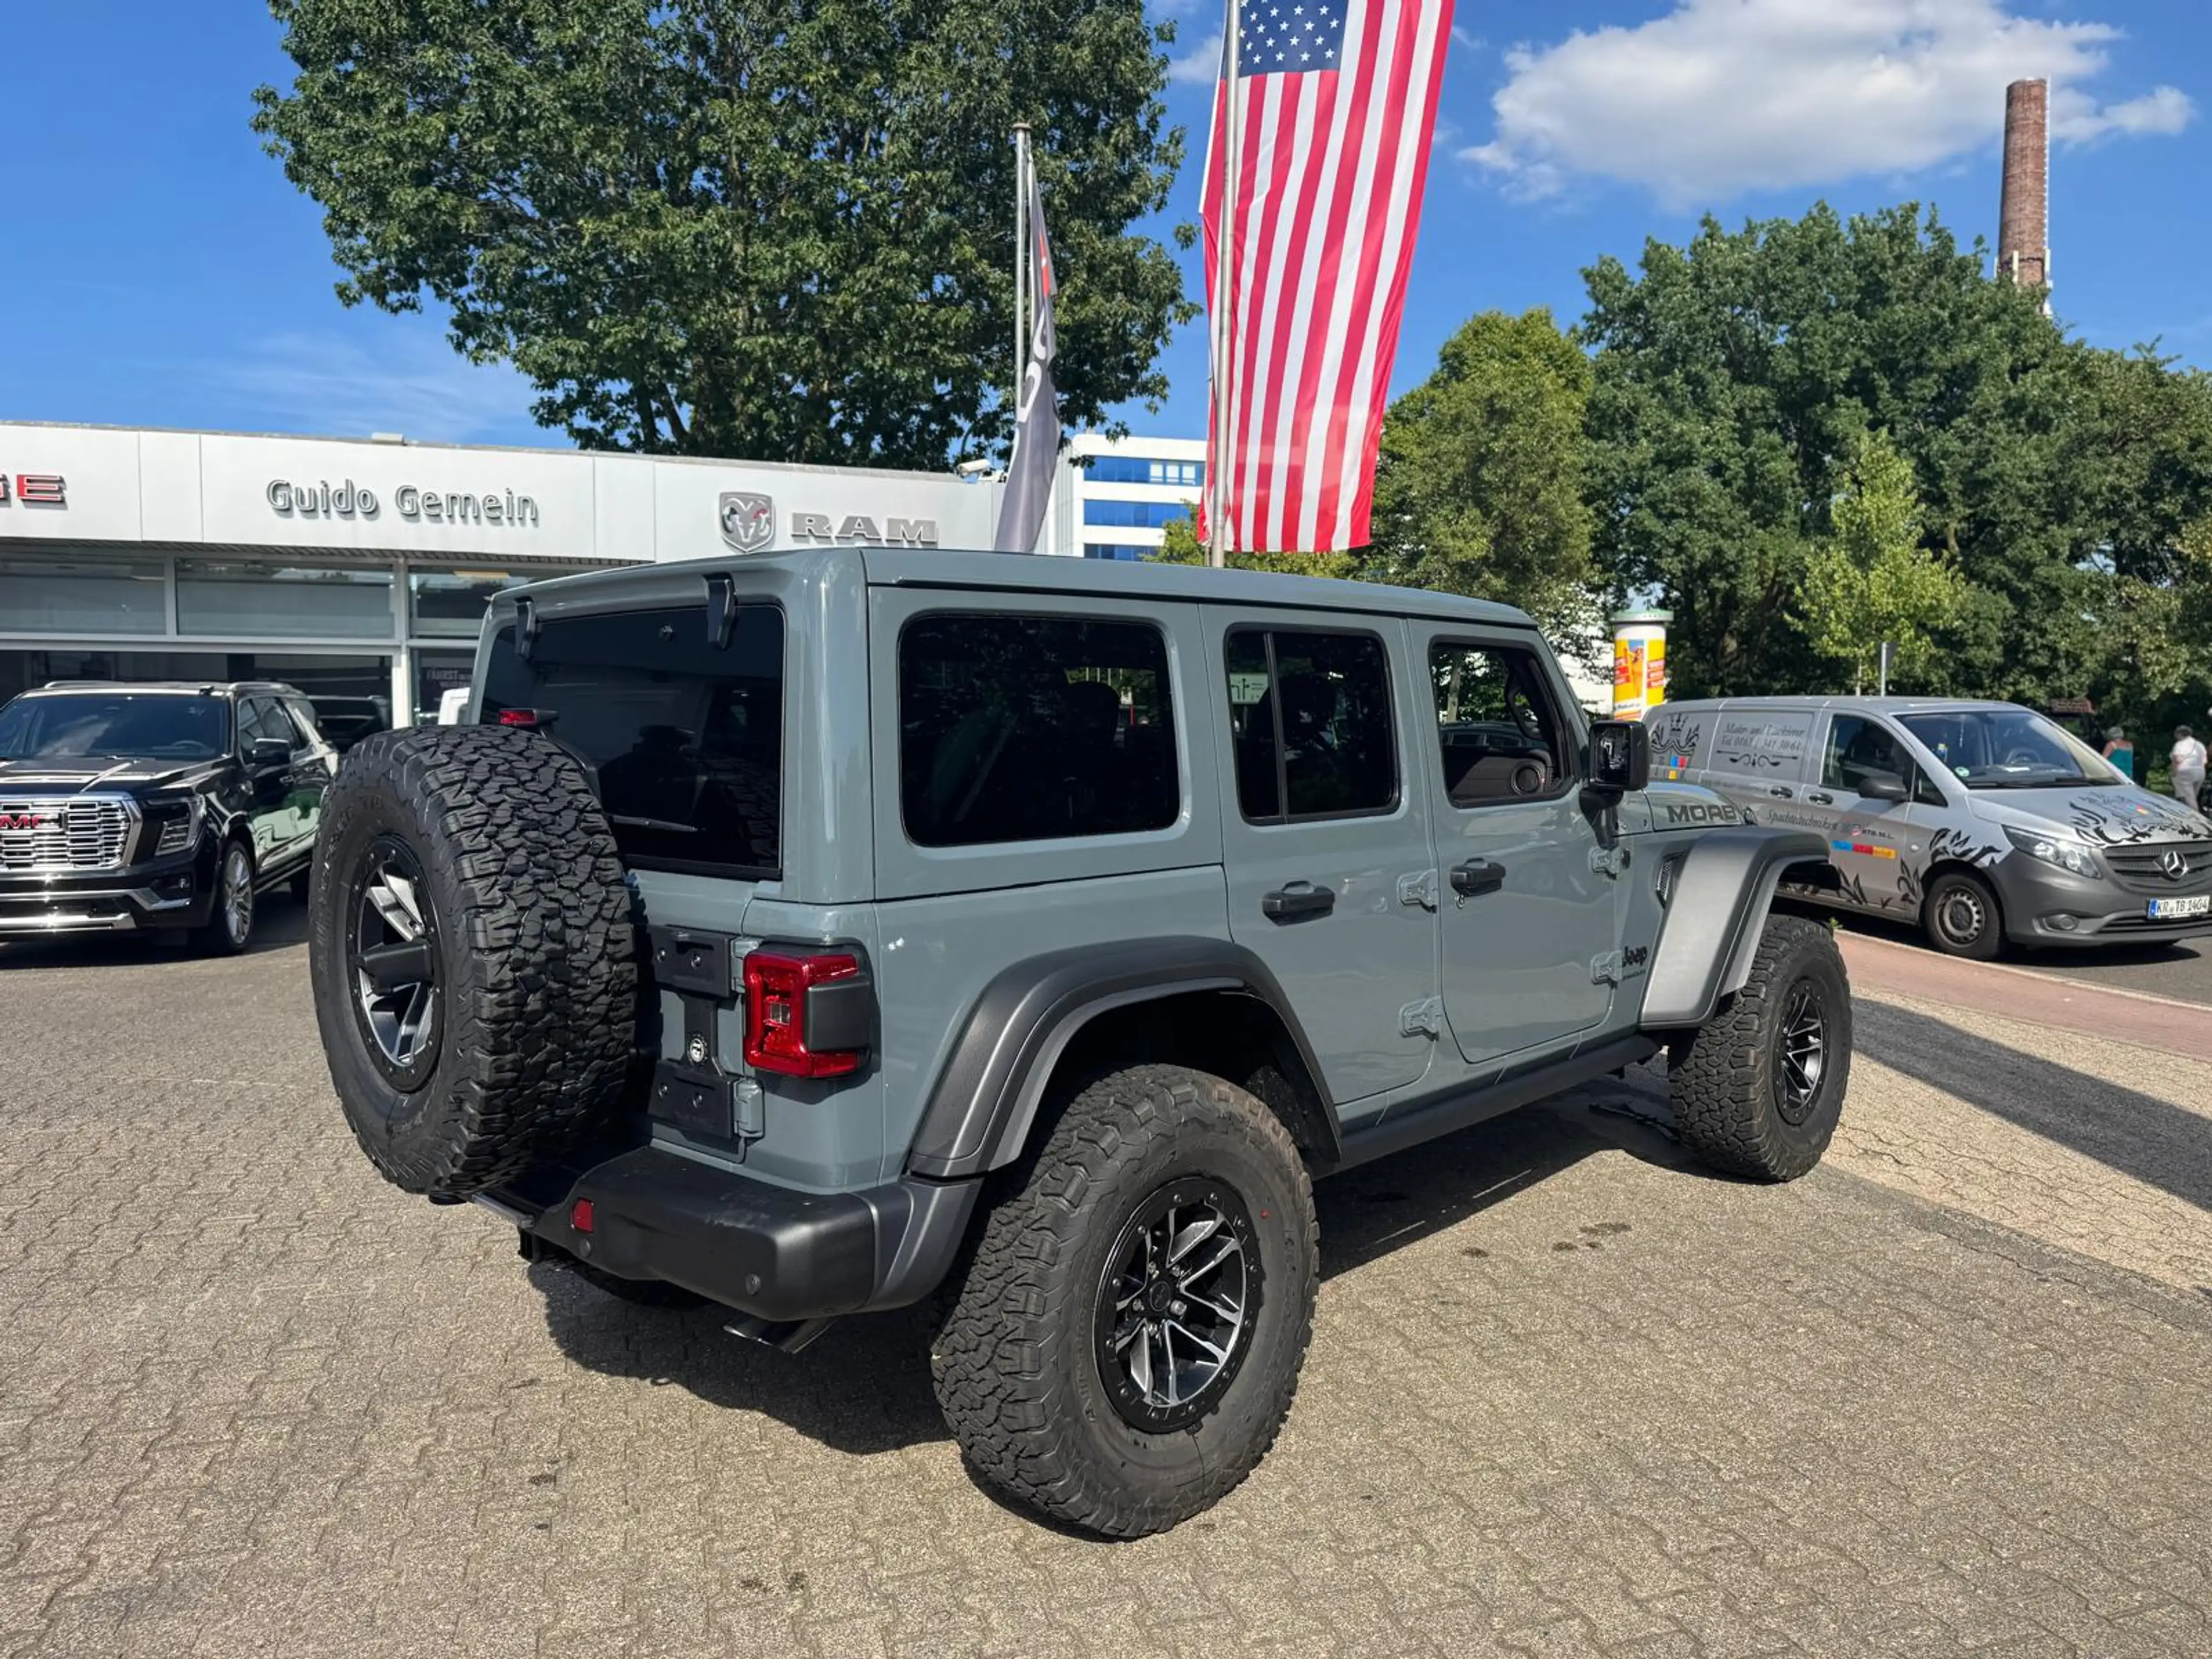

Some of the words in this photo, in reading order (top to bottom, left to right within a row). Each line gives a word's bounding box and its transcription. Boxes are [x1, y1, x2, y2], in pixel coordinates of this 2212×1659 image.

[266, 479, 378, 514] Guido
[395, 484, 539, 521] Gemein
[791, 512, 939, 544] RAM
[1622, 945, 1647, 967] Jeep
